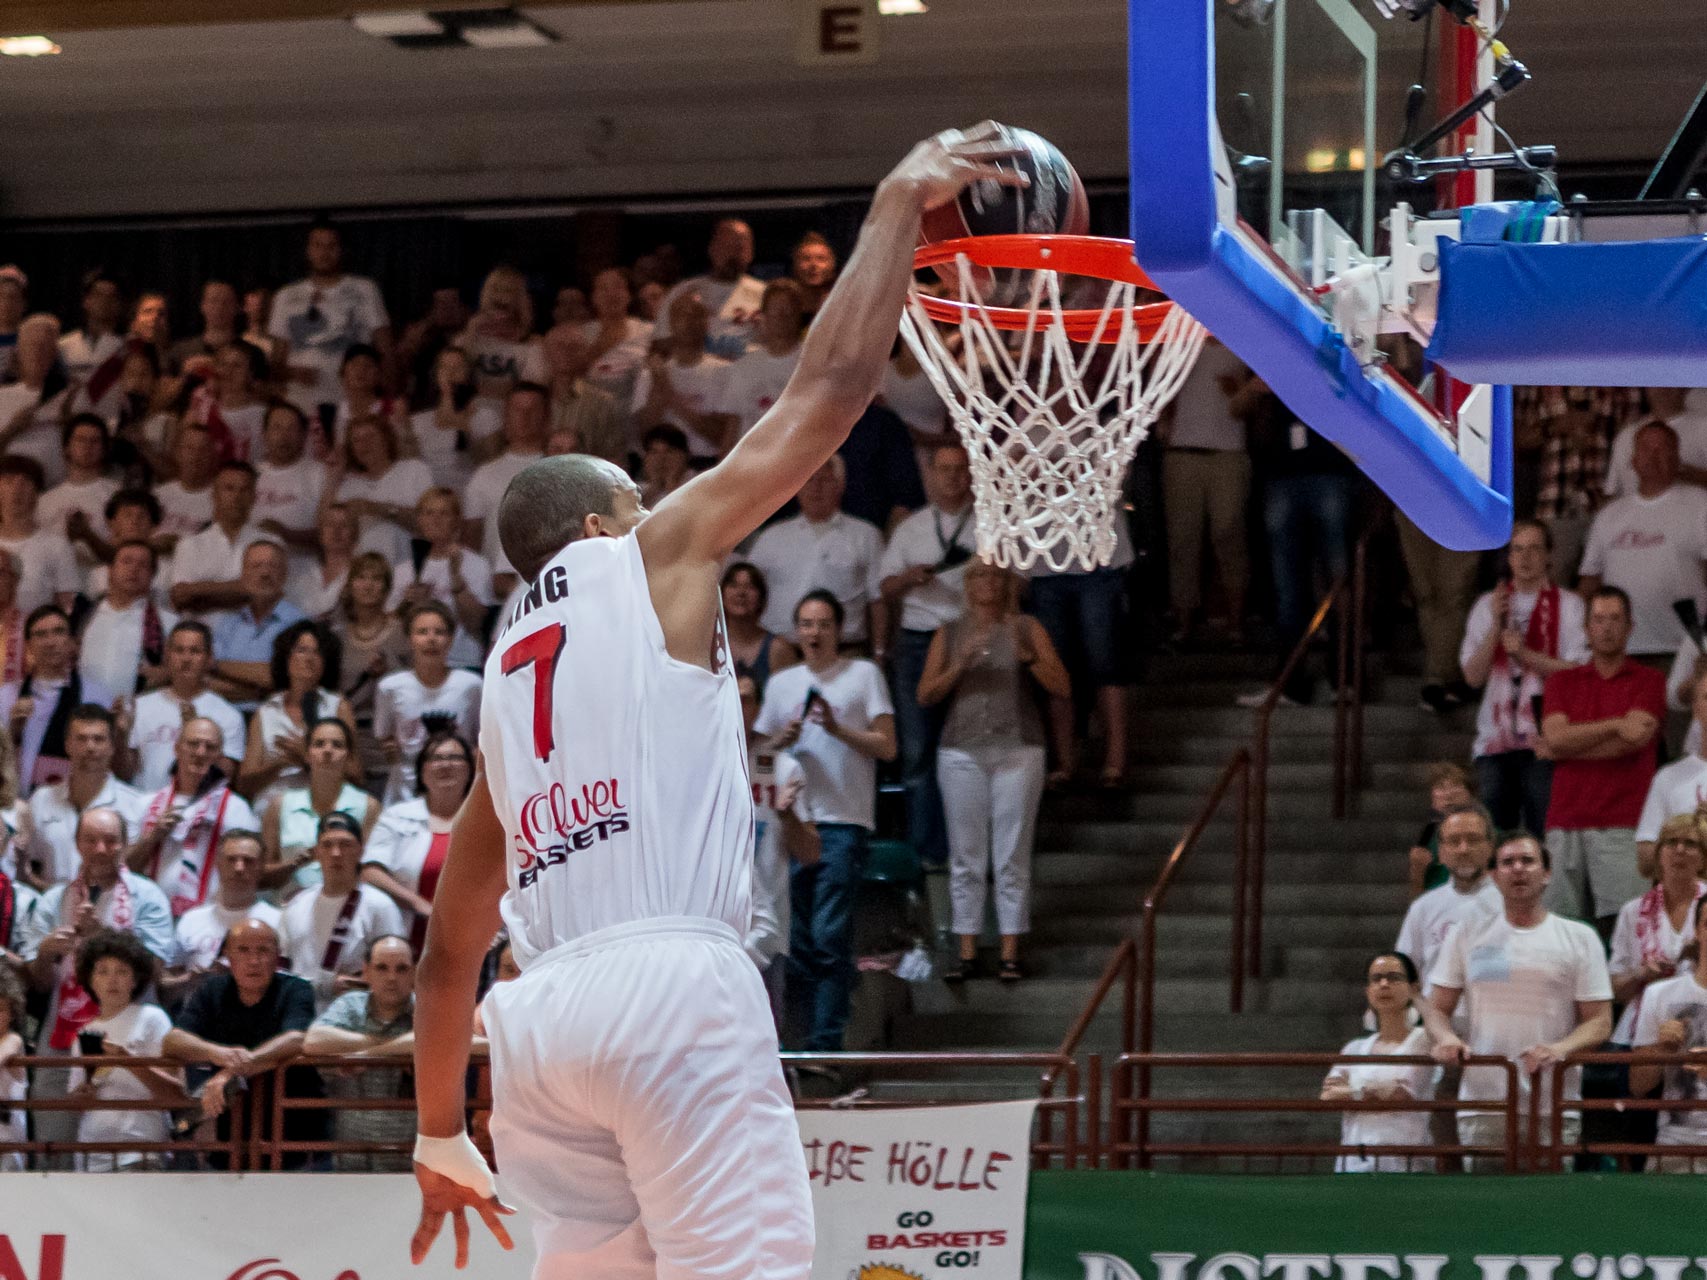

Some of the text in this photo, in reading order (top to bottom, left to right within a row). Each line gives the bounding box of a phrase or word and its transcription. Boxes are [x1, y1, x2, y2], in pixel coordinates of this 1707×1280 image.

[820, 6, 863, 53] E
[501, 622, 567, 763] 7
[887, 1140, 1013, 1191] HÖLLE
[897, 1210, 934, 1229] GO
[866, 1230, 1008, 1250] BASKETS
[935, 1250, 981, 1268] GO!
